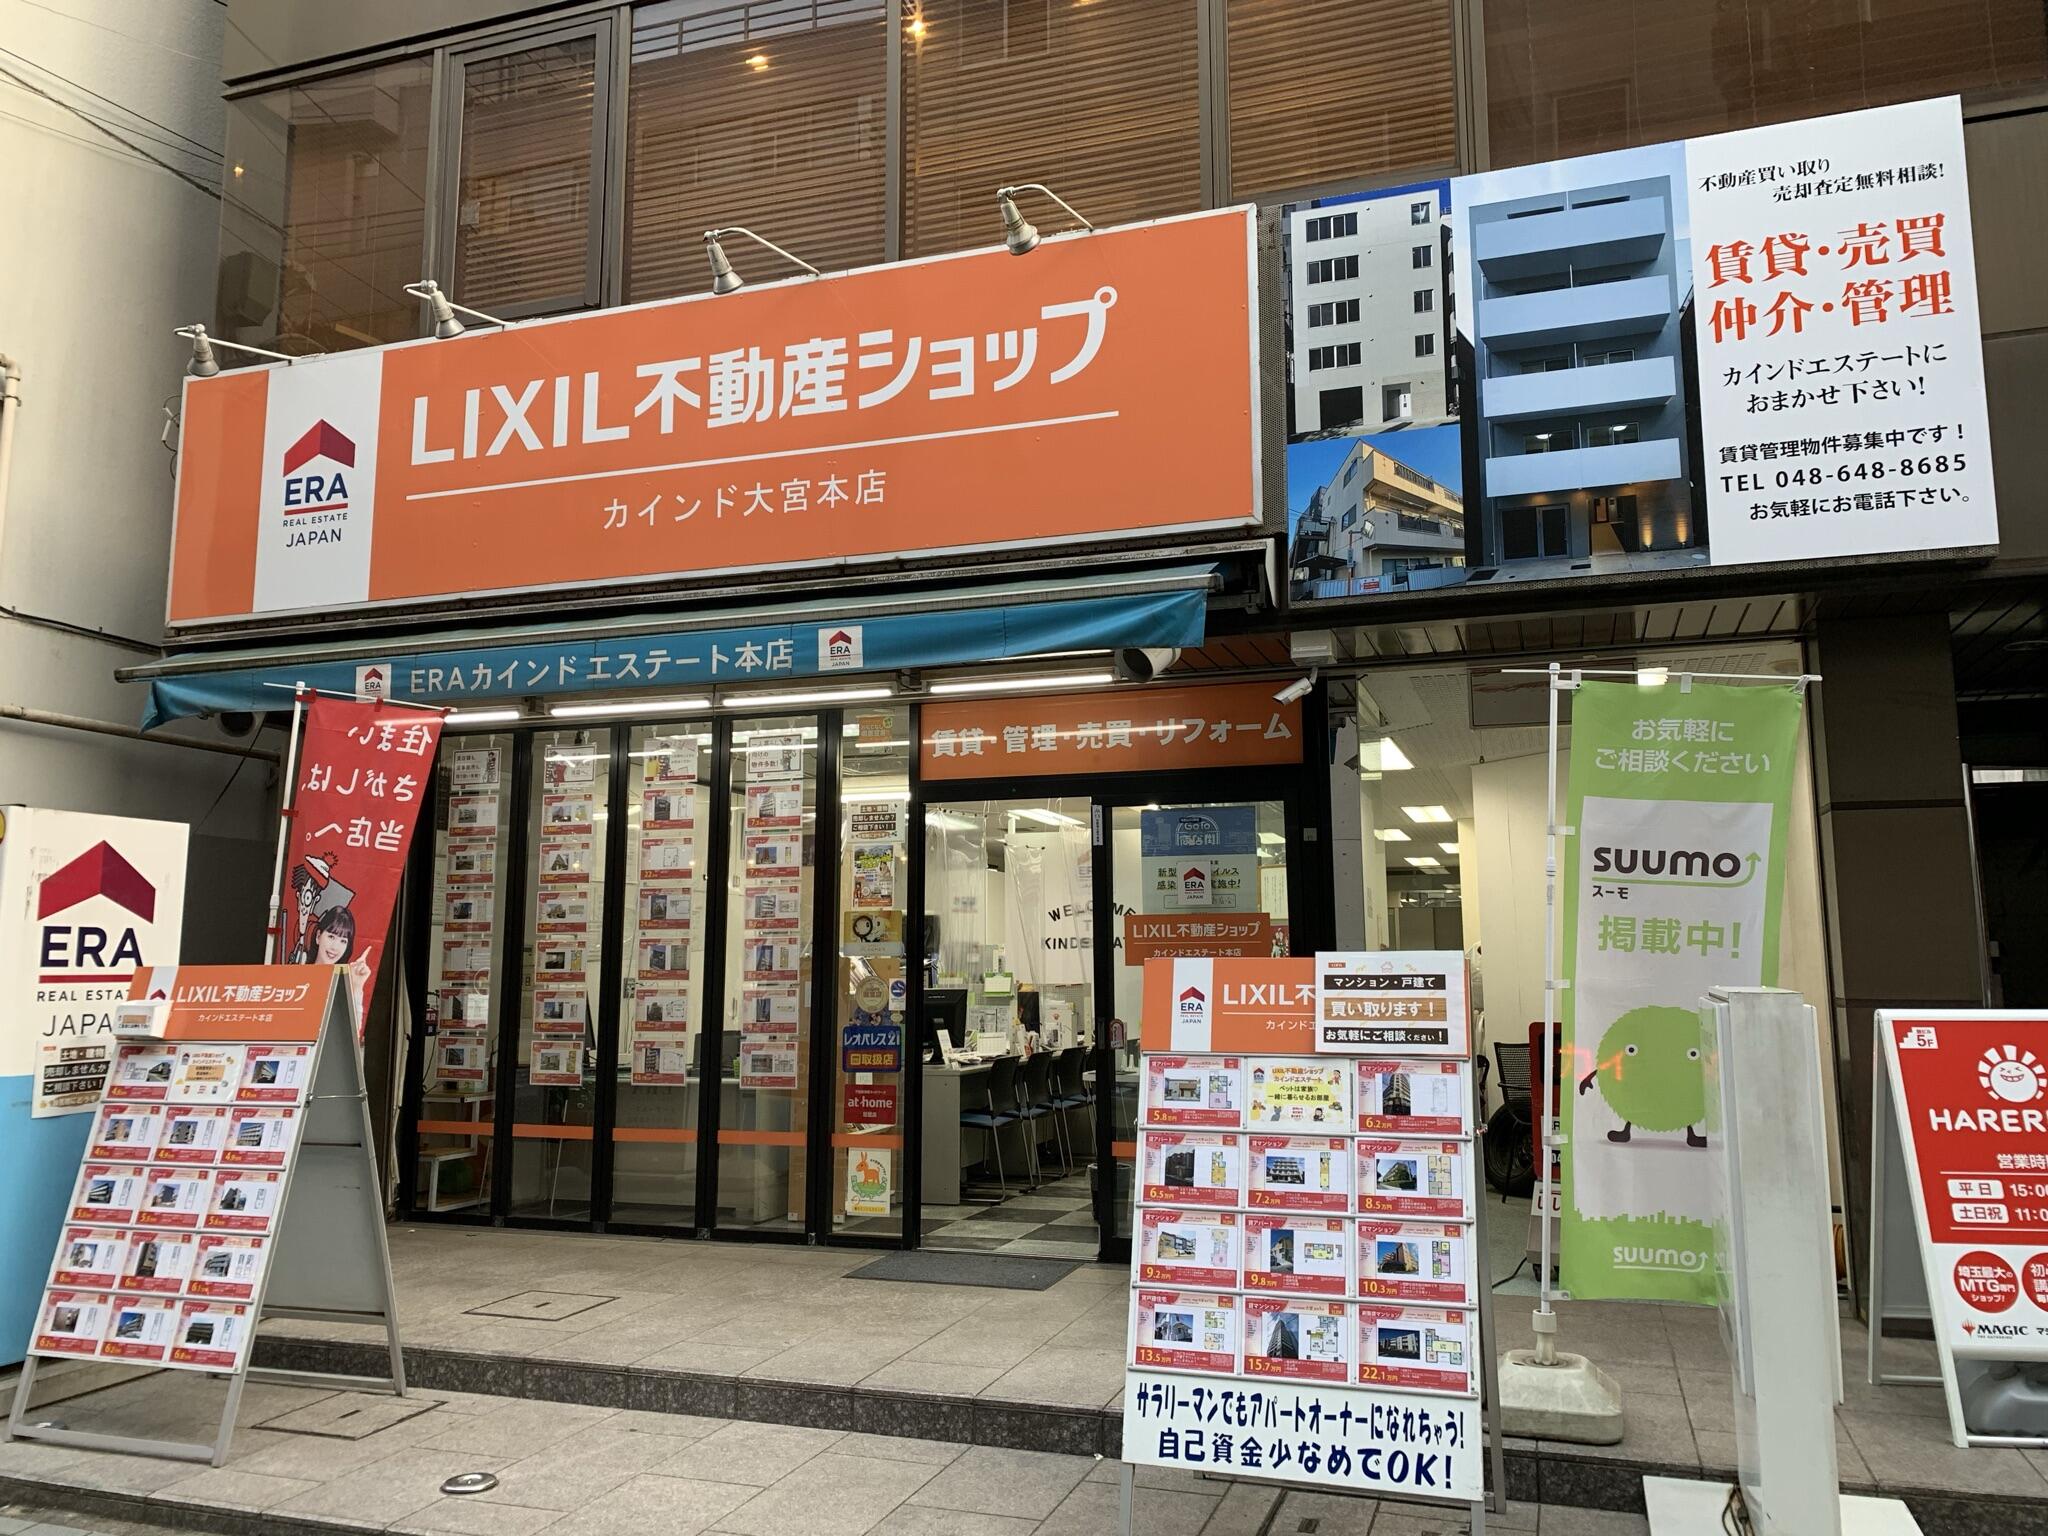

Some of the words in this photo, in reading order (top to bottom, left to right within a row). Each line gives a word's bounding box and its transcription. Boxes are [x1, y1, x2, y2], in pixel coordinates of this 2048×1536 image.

[1698, 158, 1831, 192] 不動産買い取り
[1705, 212, 1947, 289] 賃貸・売買
[1708, 270, 1956, 344] 仲介・管理
[1722, 344, 1948, 387] カインドエステートに
[1720, 474, 1765, 494] TEL
[1775, 453, 1968, 488] 048-648-8685
[284, 472, 349, 506] ERA
[603, 468, 888, 529] カインド大宮本店
[1748, 486, 1970, 521] お気軽にお電話下さい。
[282, 515, 307, 528] REAL
[310, 512, 349, 526] ESTATE
[285, 528, 343, 548] JAPAN
[830, 646, 851, 655] ERA
[364, 681, 382, 690] ERA
[1632, 719, 1735, 743] お気軽に
[1595, 748, 1770, 774] ご相談ください
[1157, 867, 1240, 878] 新型イルス
[1184, 881, 1205, 889] ERA
[1592, 885, 1629, 900] スーモ
[1132, 920, 1262, 938] LIXIL不動産ショップ
[1598, 915, 1742, 959] 掲載中!
[40, 925, 144, 968] ERA
[1333, 976, 1437, 988] マンション・戸建て
[36, 989, 78, 1002] REAL
[85, 988, 131, 1002] ESTA
[176, 982, 310, 1003] LIXIL不動産ショップ
[1180, 1002, 1204, 1011] ERA
[1330, 1000, 1435, 1017] 買い取ります！
[42, 1012, 113, 1037] JAPA
[843, 1032, 901, 1047] レオパレス21
[1928, 1108, 2048, 1133] HARER
[1997, 1153, 2048, 1169] 営業時
[1959, 1182, 1993, 1196] 平日
[2030, 1264, 2048, 1278] 初
[1977, 1324, 2030, 1336] MAGIC
